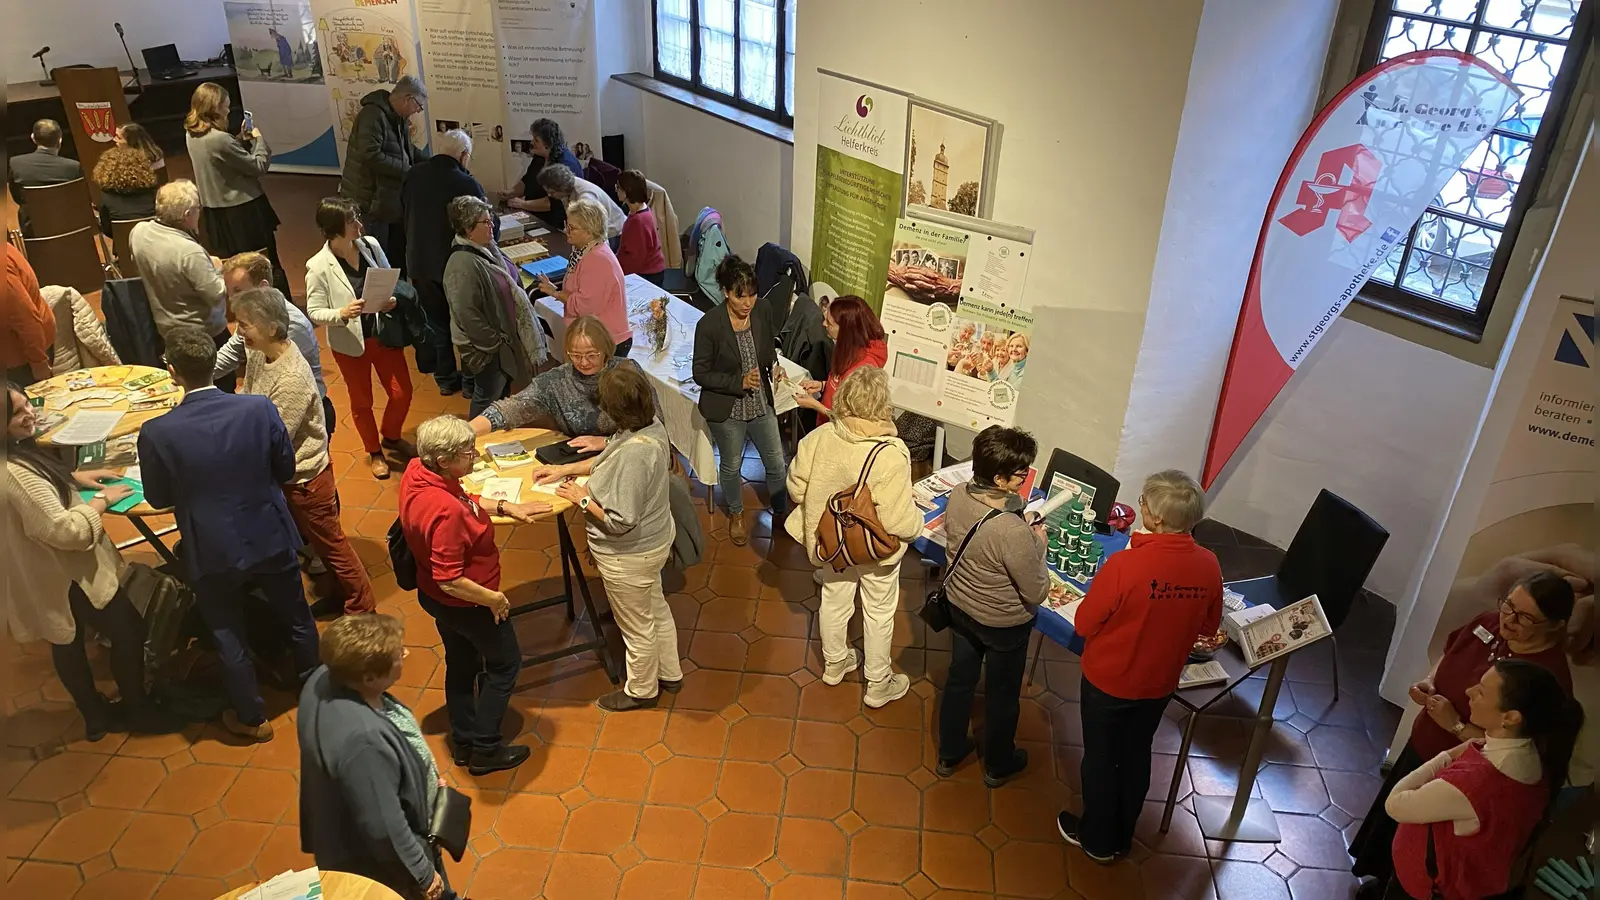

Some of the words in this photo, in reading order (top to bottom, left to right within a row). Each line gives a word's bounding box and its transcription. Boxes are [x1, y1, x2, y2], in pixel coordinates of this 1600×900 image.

[833, 115, 886, 146] Lichtblick
[841, 136, 879, 157] Helferkreis
[899, 223, 922, 234] Demenz
[931, 231, 941, 239] der
[942, 233, 967, 244] Familie?
[960, 300, 980, 310] Demenz
[981, 305, 994, 313] kann
[994, 309, 1013, 319] jede(n)
[1014, 314, 1034, 324] treffen!
[1289, 244, 1388, 363] www.stgeorgs-apotheke.de
[990, 400, 1009, 410] Apotheke
[1534, 405, 1580, 425] beraten
